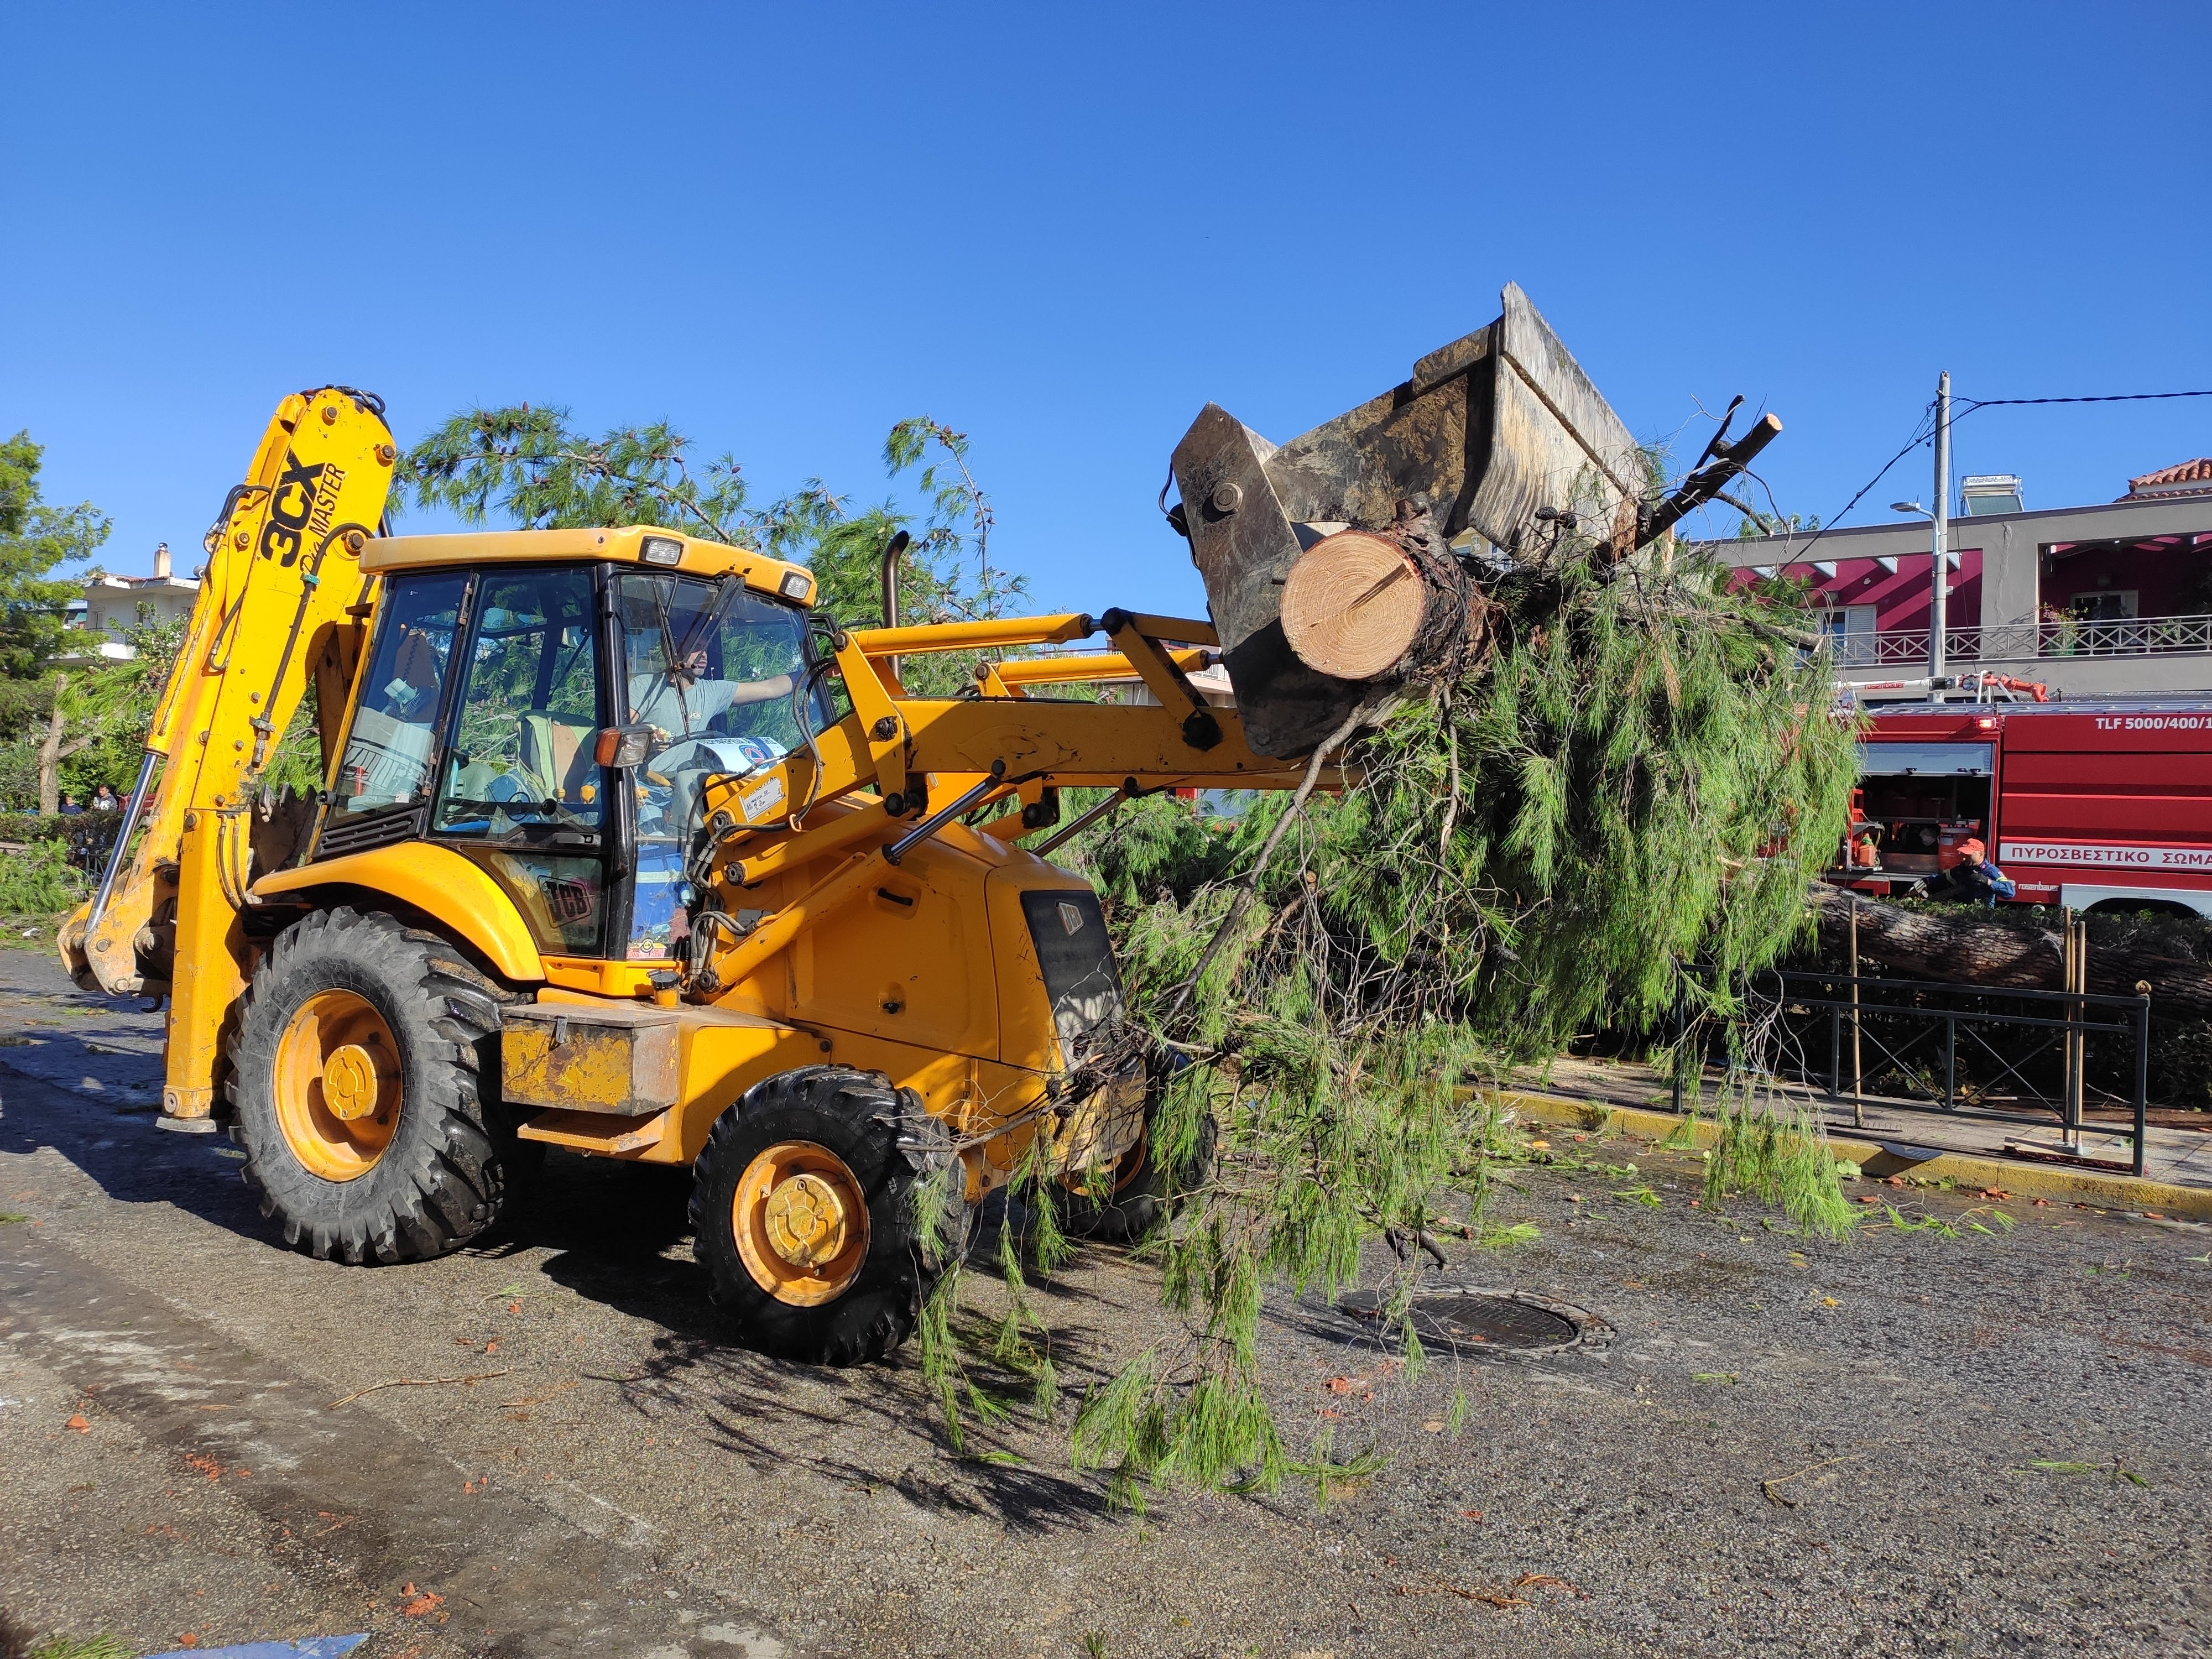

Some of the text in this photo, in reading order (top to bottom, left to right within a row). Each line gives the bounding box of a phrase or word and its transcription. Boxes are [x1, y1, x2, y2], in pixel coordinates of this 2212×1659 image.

[260, 448, 317, 567] 3CX
[309, 463, 345, 539] MASTER
[1864, 681, 1905, 690] rosenbauer
[2095, 717, 2212, 729] TLF 5000/400/1
[2012, 847, 2150, 863] ΠΥΡΟΣΒΕΣΤΙΚΟ
[2018, 880, 2059, 891] rosenbauer
[546, 881, 588, 924] JCB
[1061, 904, 1082, 932] JCB
